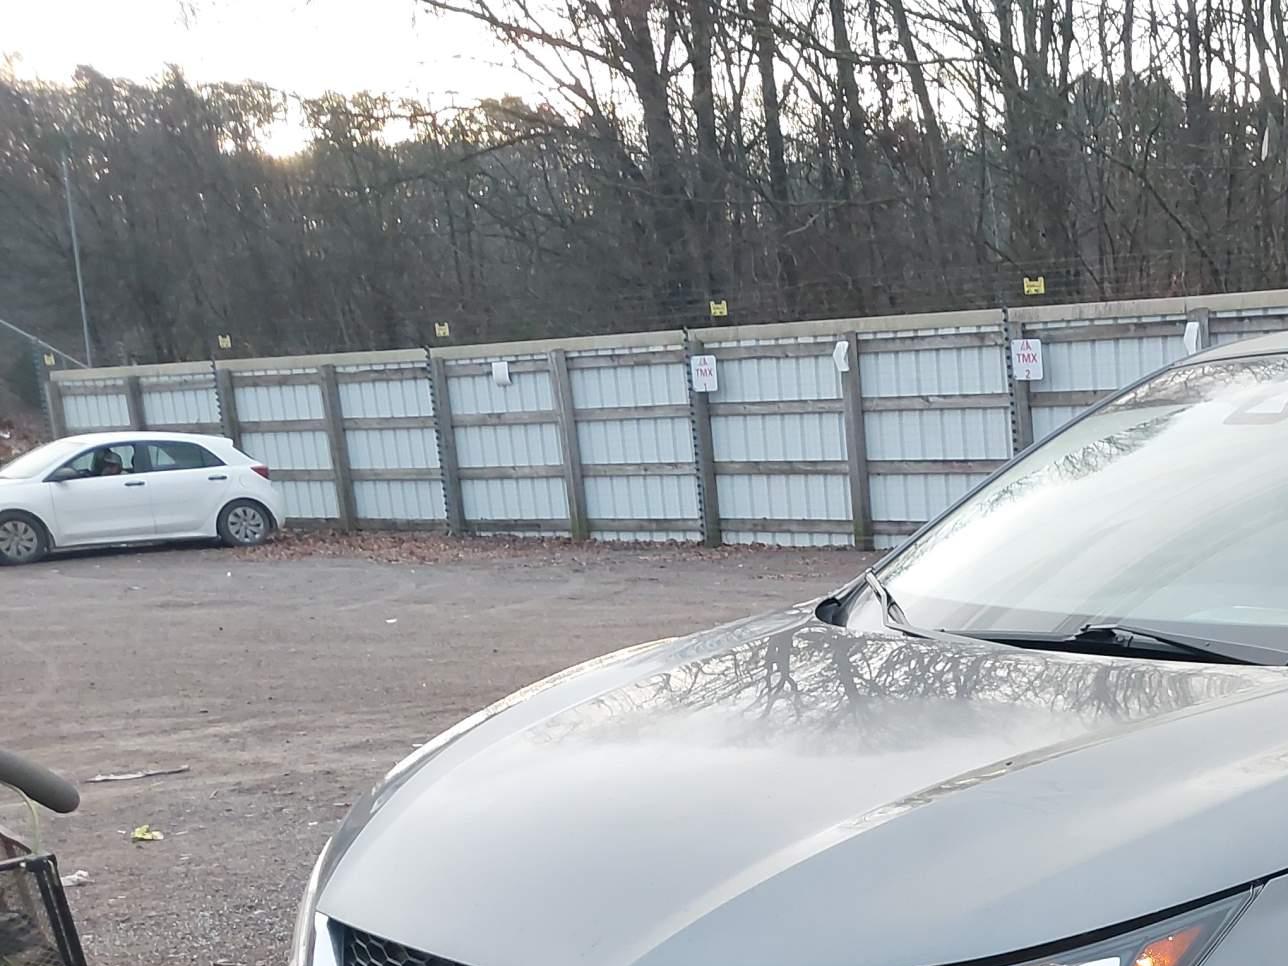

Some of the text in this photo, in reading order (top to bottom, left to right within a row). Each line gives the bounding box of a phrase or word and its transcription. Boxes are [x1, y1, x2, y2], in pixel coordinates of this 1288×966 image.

[1016, 353, 1038, 363] TMX
[696, 368, 713, 377] TMX
[1025, 369, 1031, 379] 2
